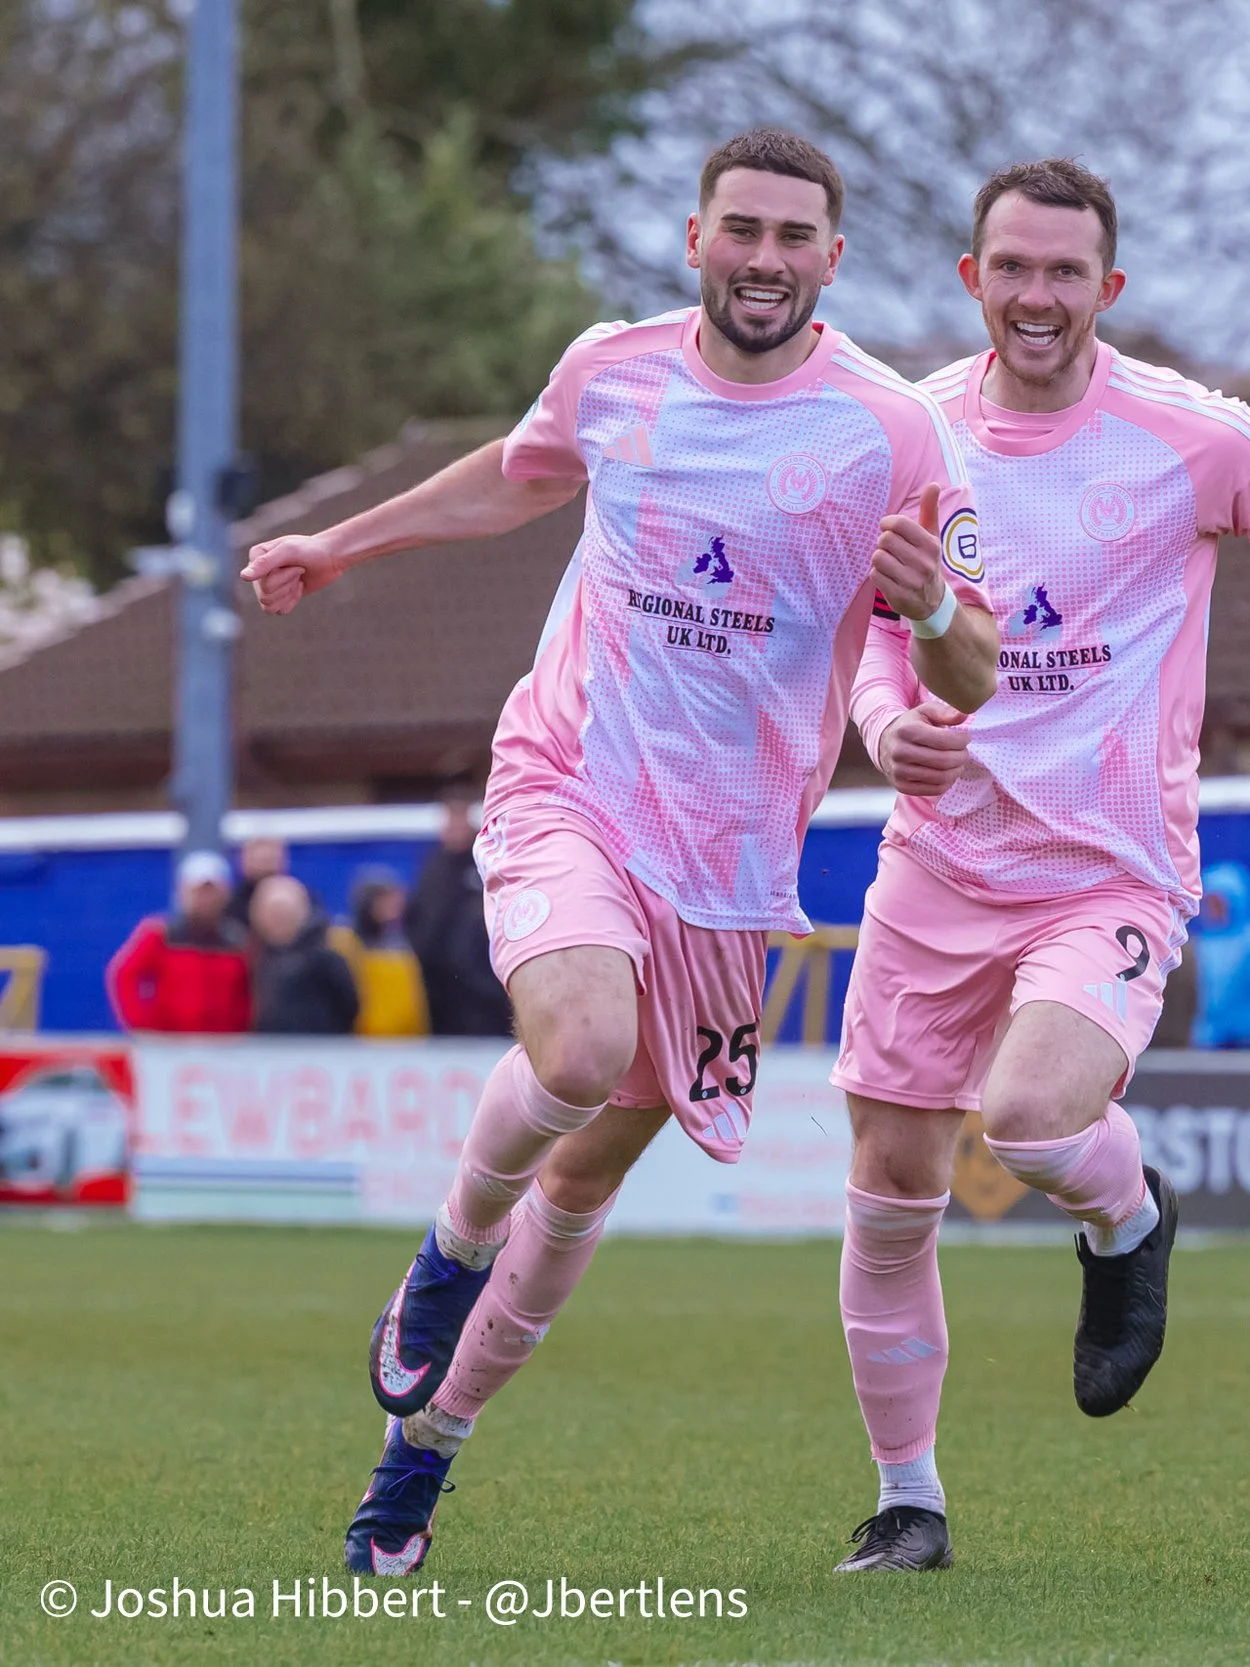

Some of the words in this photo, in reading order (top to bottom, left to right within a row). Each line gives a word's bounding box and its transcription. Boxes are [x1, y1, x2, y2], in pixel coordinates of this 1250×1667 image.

[958, 534, 977, 559] B
[710, 608, 775, 633] STEELS
[667, 626, 693, 646] UK
[697, 631, 732, 654] LTD.
[997, 650, 1041, 669] ONAL
[1046, 645, 1112, 669] STEELS
[1008, 676, 1034, 692] UK
[1037, 674, 1075, 692] LTD.
[1115, 925, 1150, 982] 9
[689, 1022, 757, 1102] 25
